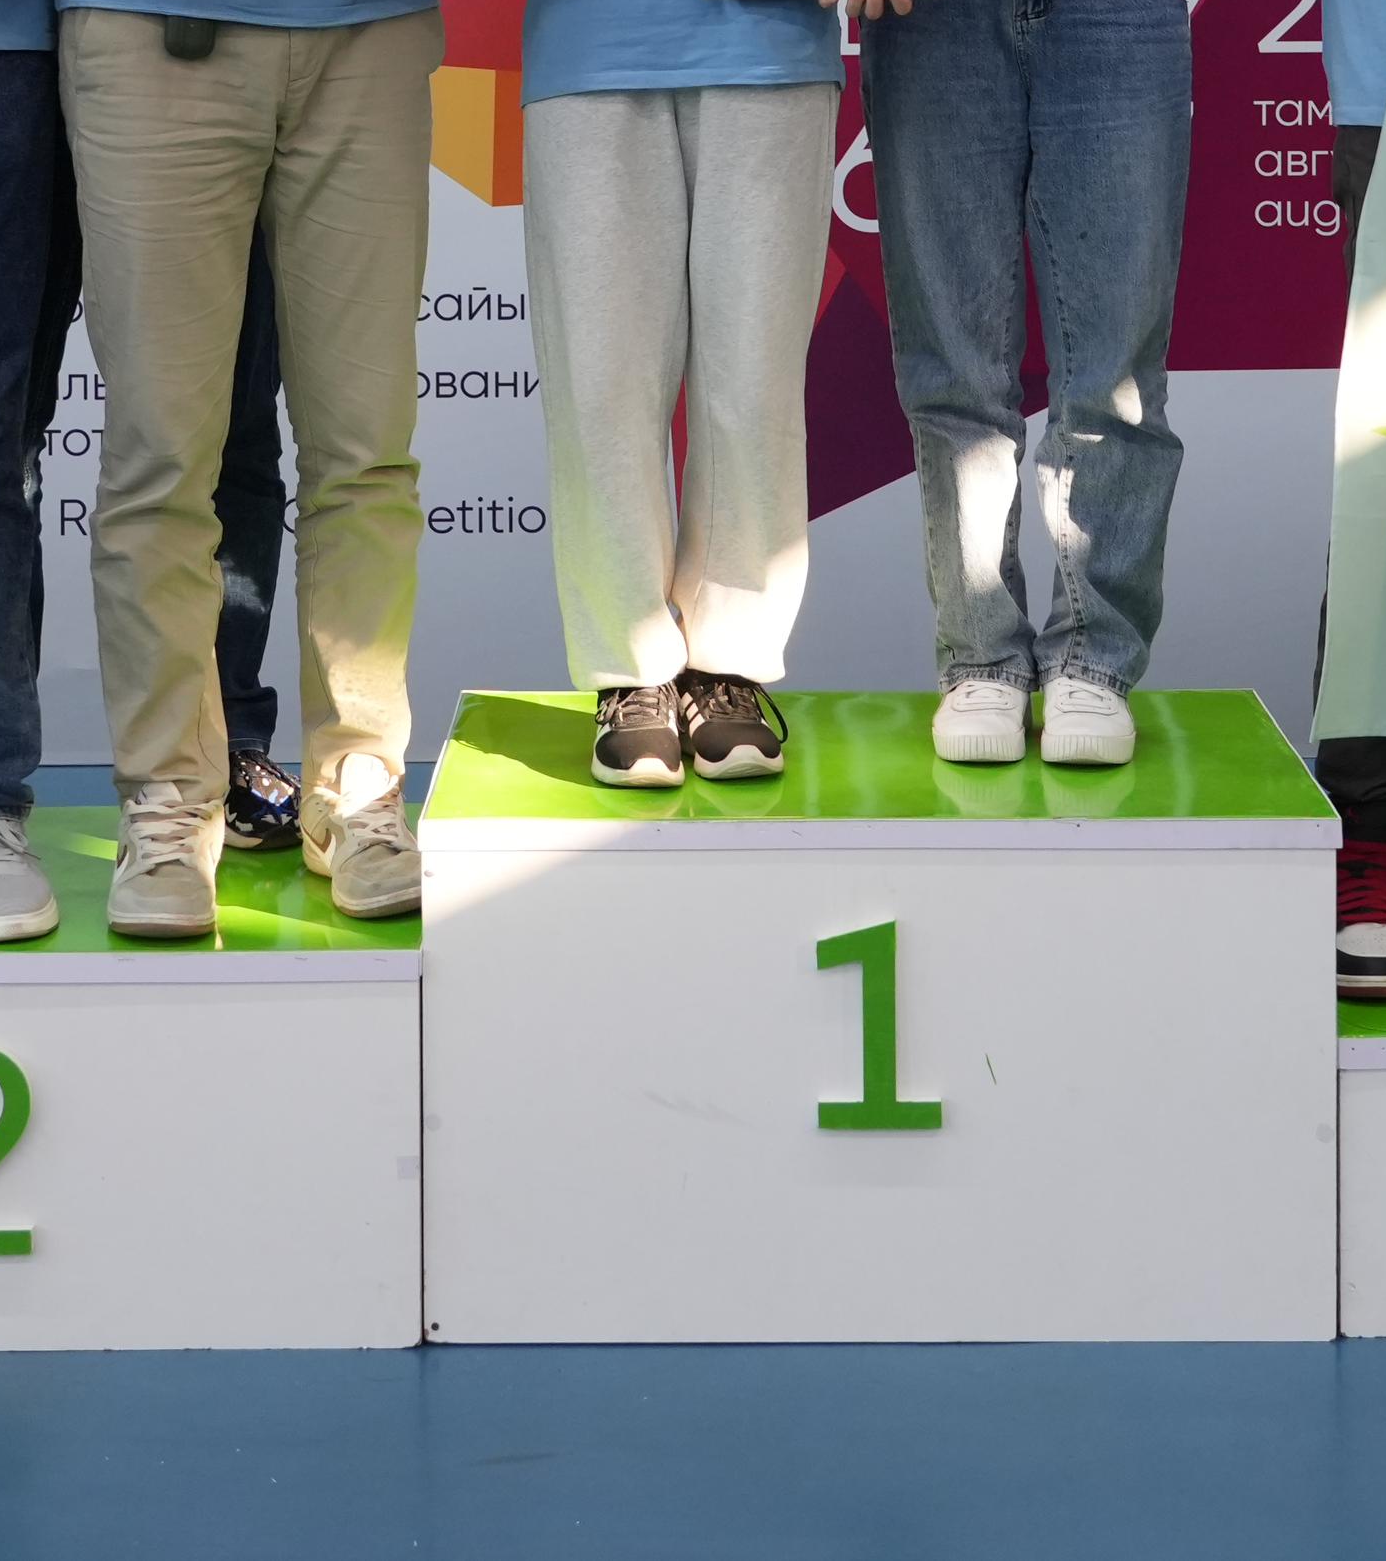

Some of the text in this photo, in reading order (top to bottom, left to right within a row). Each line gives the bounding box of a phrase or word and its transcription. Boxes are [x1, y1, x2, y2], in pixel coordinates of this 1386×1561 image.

[1253, 100, 1333, 126] там
[1254, 200, 1341, 236] aug
[816, 920, 942, 1129] 1
